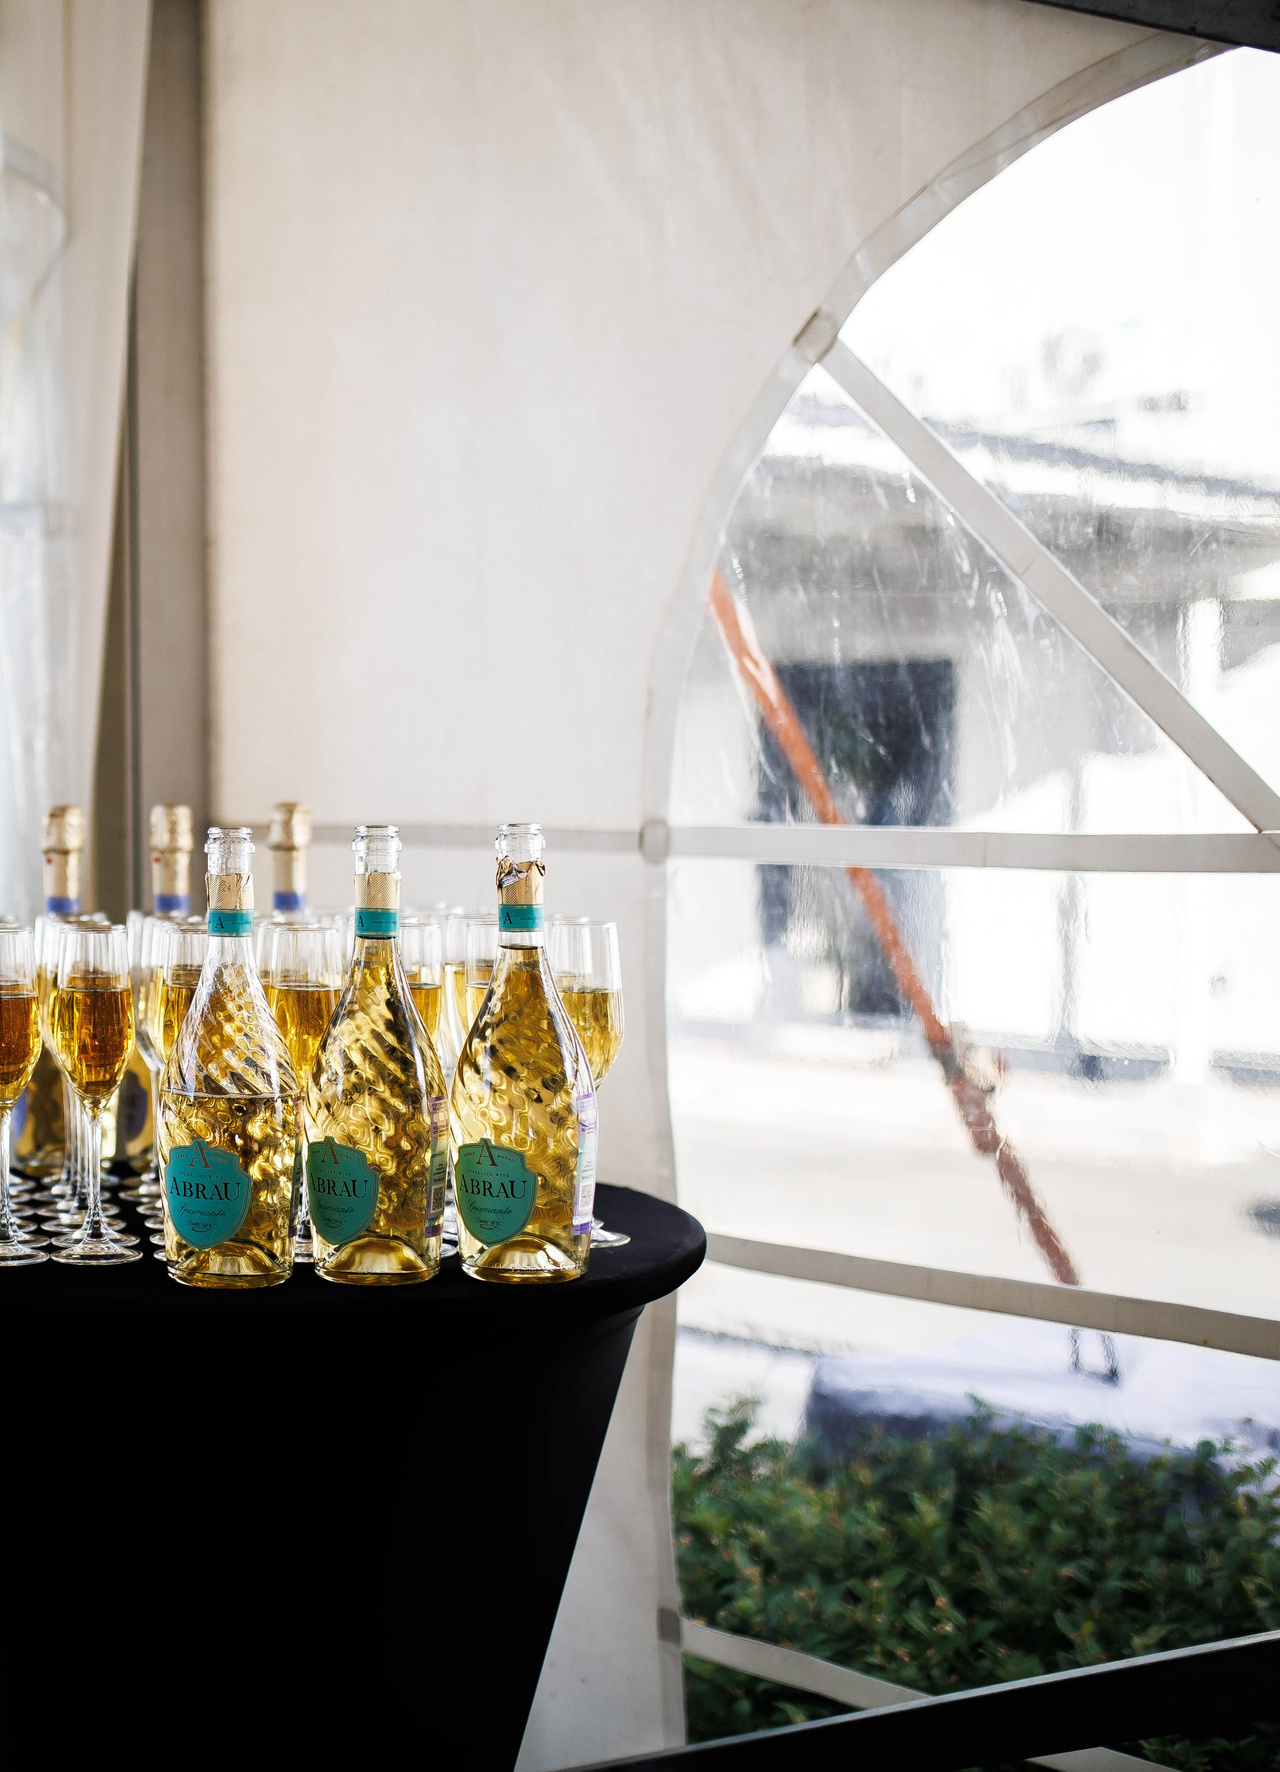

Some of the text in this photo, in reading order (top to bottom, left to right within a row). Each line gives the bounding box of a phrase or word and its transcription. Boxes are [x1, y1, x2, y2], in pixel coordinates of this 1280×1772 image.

[215, 916, 225, 929] A
[356, 915, 365, 928] A
[503, 911, 513, 925] A
[187, 1140, 213, 1169] A
[321, 1138, 340, 1165] A
[475, 1139, 499, 1167] A
[169, 1176, 241, 1202] ABRAU
[310, 1172, 368, 1199] ABRAU
[459, 1173, 528, 1200] ABRAU
[176, 1201, 227, 1217] Spumante
[466, 1199, 513, 1215] Spumante
